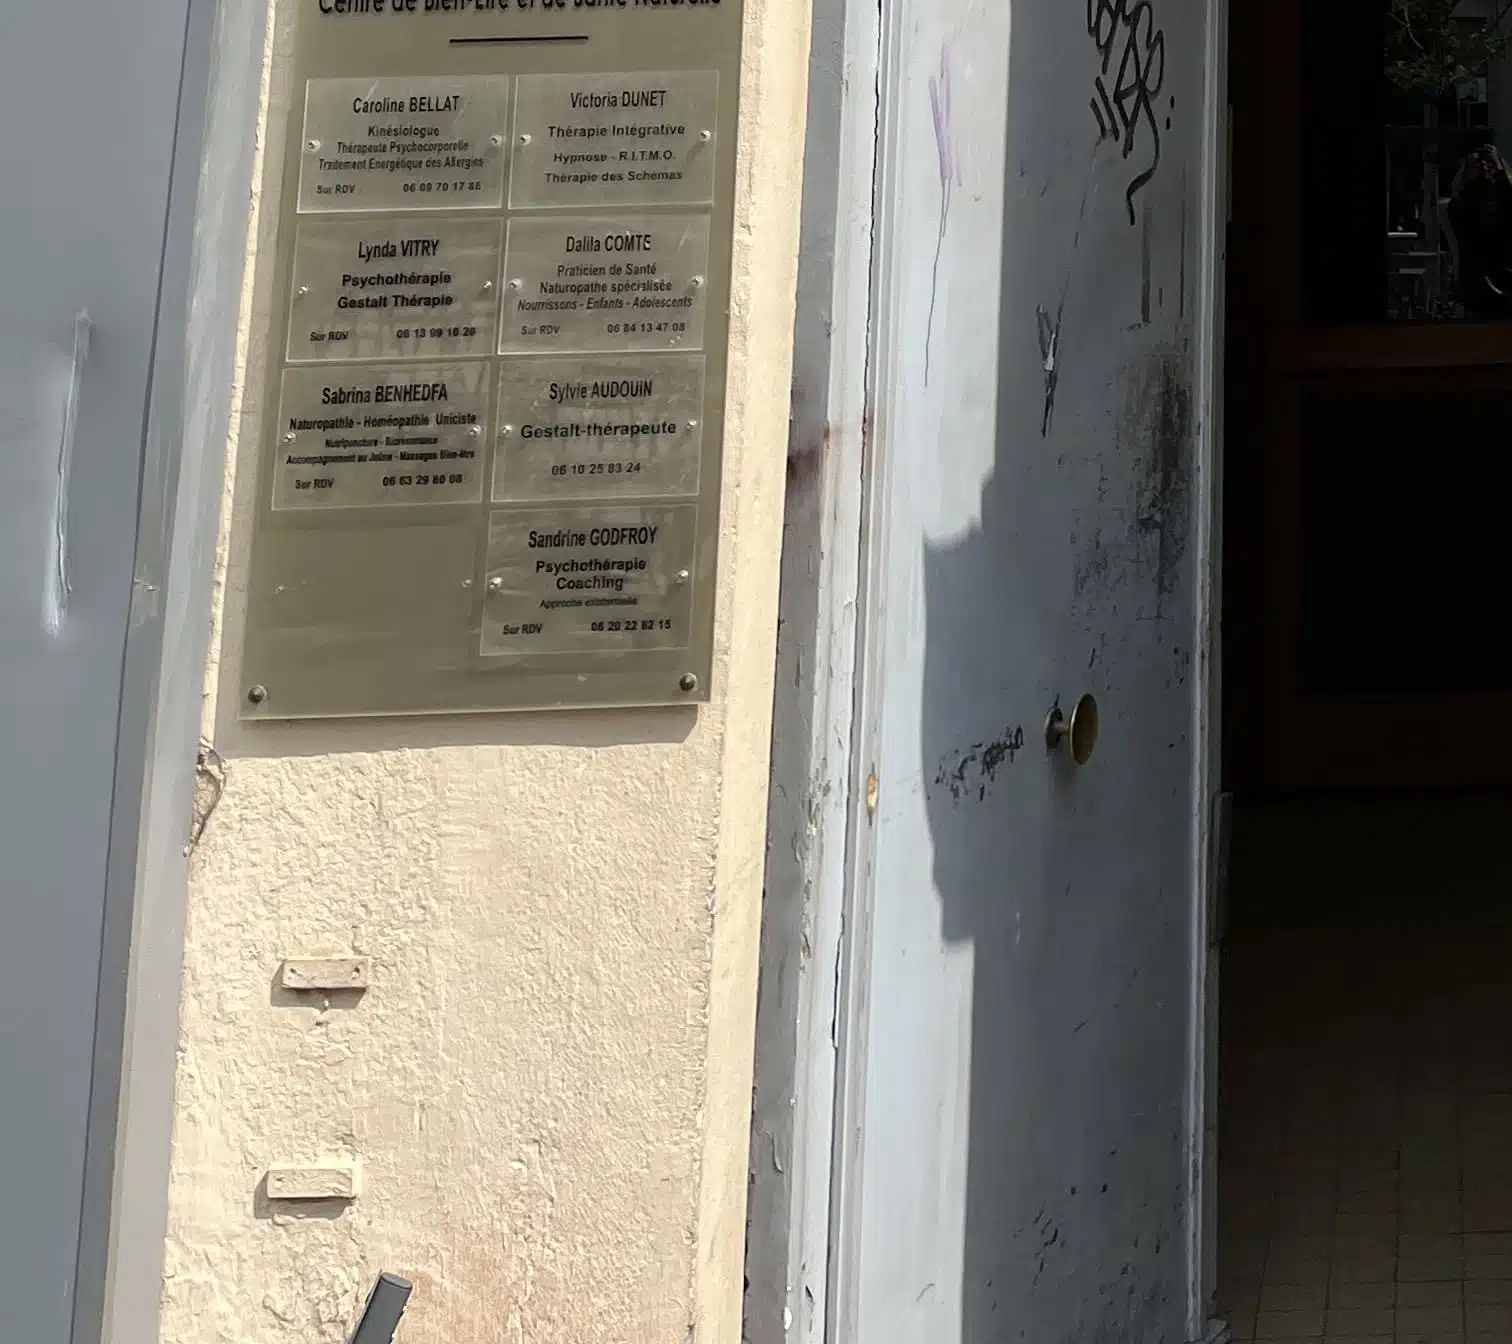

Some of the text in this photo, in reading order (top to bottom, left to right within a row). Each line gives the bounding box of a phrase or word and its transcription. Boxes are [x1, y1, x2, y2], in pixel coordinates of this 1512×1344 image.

[353, 96, 459, 114] Caroline BELLAT
[571, 90, 667, 109] Victoria DUNET
[368, 125, 440, 138] Kinésiologue
[548, 123, 685, 139] Thérapie Intégrative
[553, 153, 607, 164] Hypnose
[544, 172, 597, 184] Thérapie
[602, 172, 623, 182] des
[335, 183, 355, 194] RDV
[403, 183, 415, 193] 06
[420, 183, 432, 192] 09
[436, 182, 448, 192] 70
[453, 182, 465, 191] 17
[358, 239, 440, 263] Lynda VITRY
[566, 234, 652, 253] Dalila COMTE
[557, 263, 656, 278] Praticien de Santé
[342, 272, 452, 289] Psychothérapie
[540, 279, 672, 296] Naturopathe spécialisée
[338, 294, 453, 310] Gestalt Thérapie
[587, 298, 623, 310] Enfants
[633, 296, 692, 308] Adolescents
[310, 332, 326, 342] Sur
[328, 331, 349, 341] RDV
[521, 326, 537, 335] Sur
[540, 325, 560, 334] RDV
[608, 323, 620, 333] 06
[641, 323, 653, 332] 13
[656, 322, 668, 332] 47
[322, 383, 448, 405] Sabrina BENHEDFA
[549, 380, 652, 404] Sylvie AUDOUIN
[289, 417, 354, 432] Naturopathie
[436, 413, 476, 425] Uniciste
[521, 421, 677, 438] Gestalt-thérapeute
[552, 464, 566, 475] 06
[571, 464, 585, 474] 10
[590, 464, 603, 474] 25
[626, 462, 641, 473] 24
[313, 478, 334, 488] RDV
[382, 476, 395, 486] 06
[416, 475, 429, 485] 29
[528, 526, 657, 548] Sandrine GODFROY
[536, 557, 646, 576] Psychothérapie
[556, 576, 624, 591] Coaching
[503, 624, 519, 635] Sur
[522, 623, 543, 633] RDV
[624, 620, 637, 630] 22
[659, 619, 671, 629] 15
